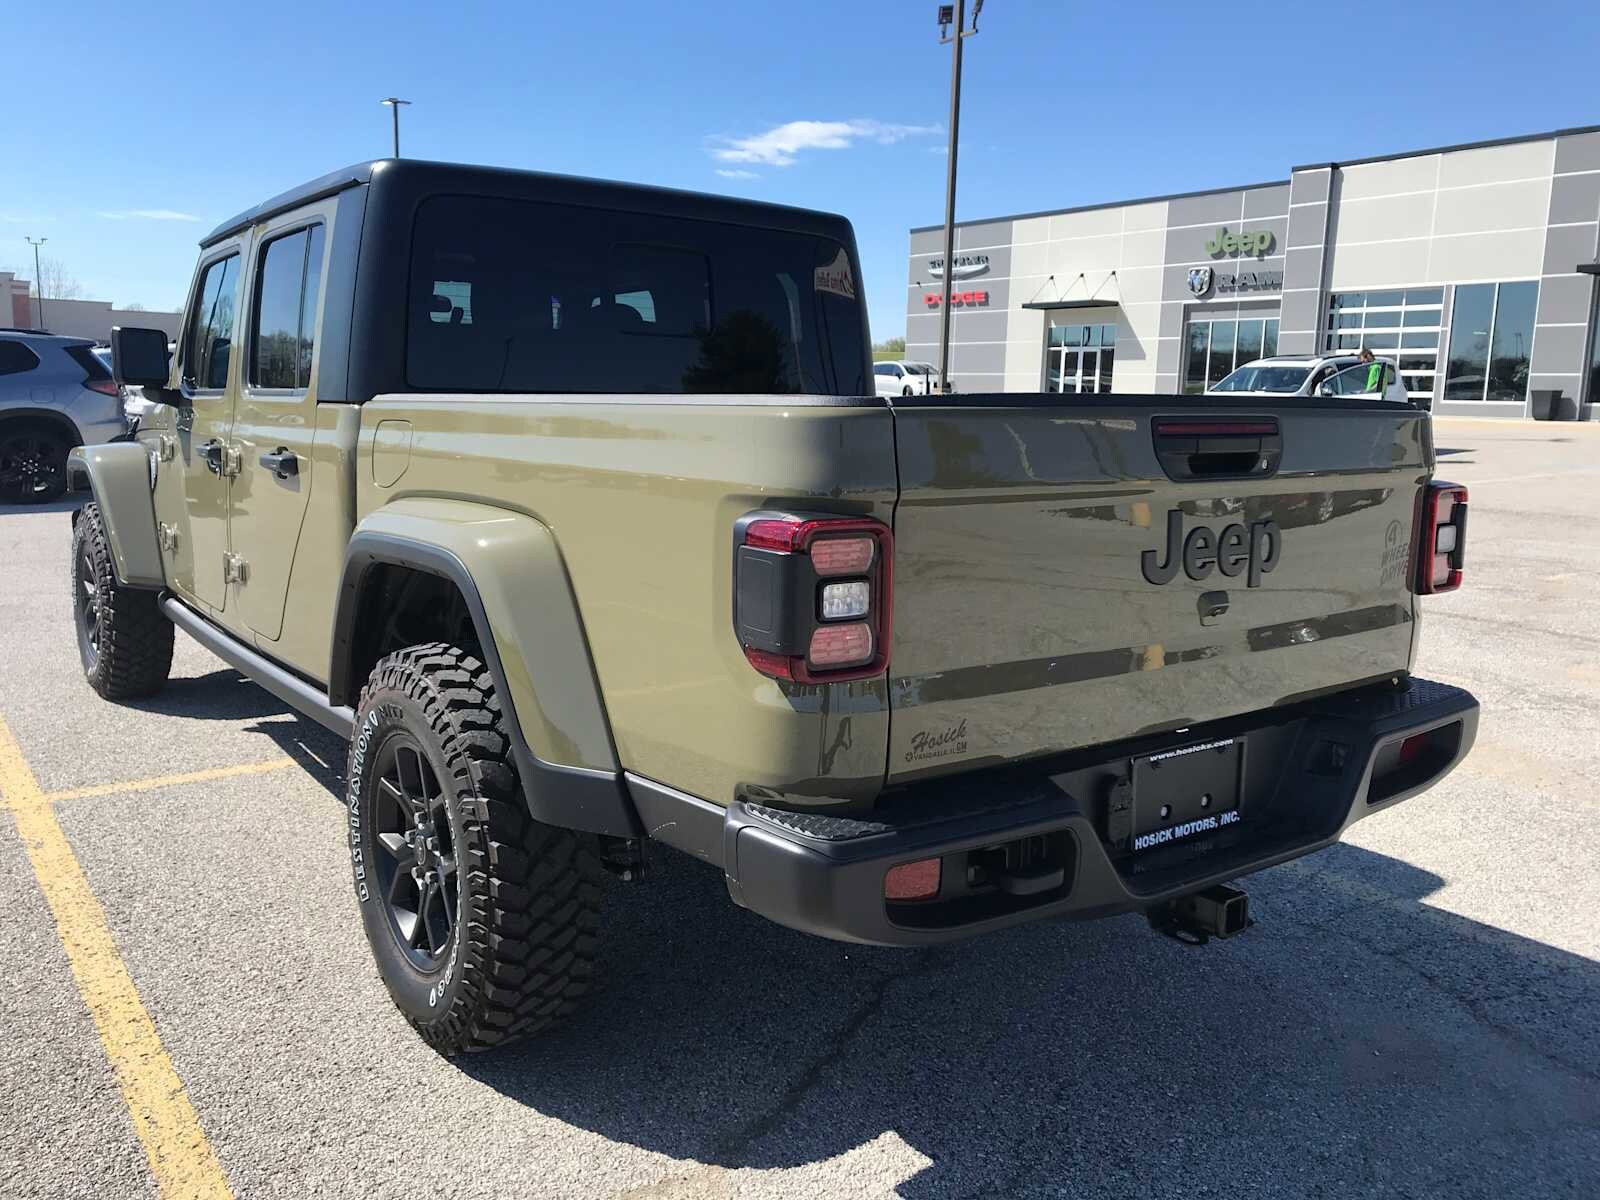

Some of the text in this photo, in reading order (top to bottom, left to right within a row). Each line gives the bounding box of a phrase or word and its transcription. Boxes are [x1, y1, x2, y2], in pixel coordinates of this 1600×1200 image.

[1204, 226, 1273, 257] Jeep
[1216, 271, 1283, 289] RAM
[1141, 509, 1282, 588] Jeep
[911, 718, 968, 752] Hosick
[1149, 738, 1234, 762] www.hosicks.com
[1134, 810, 1240, 851] HOSICK MOTORS, INC.
